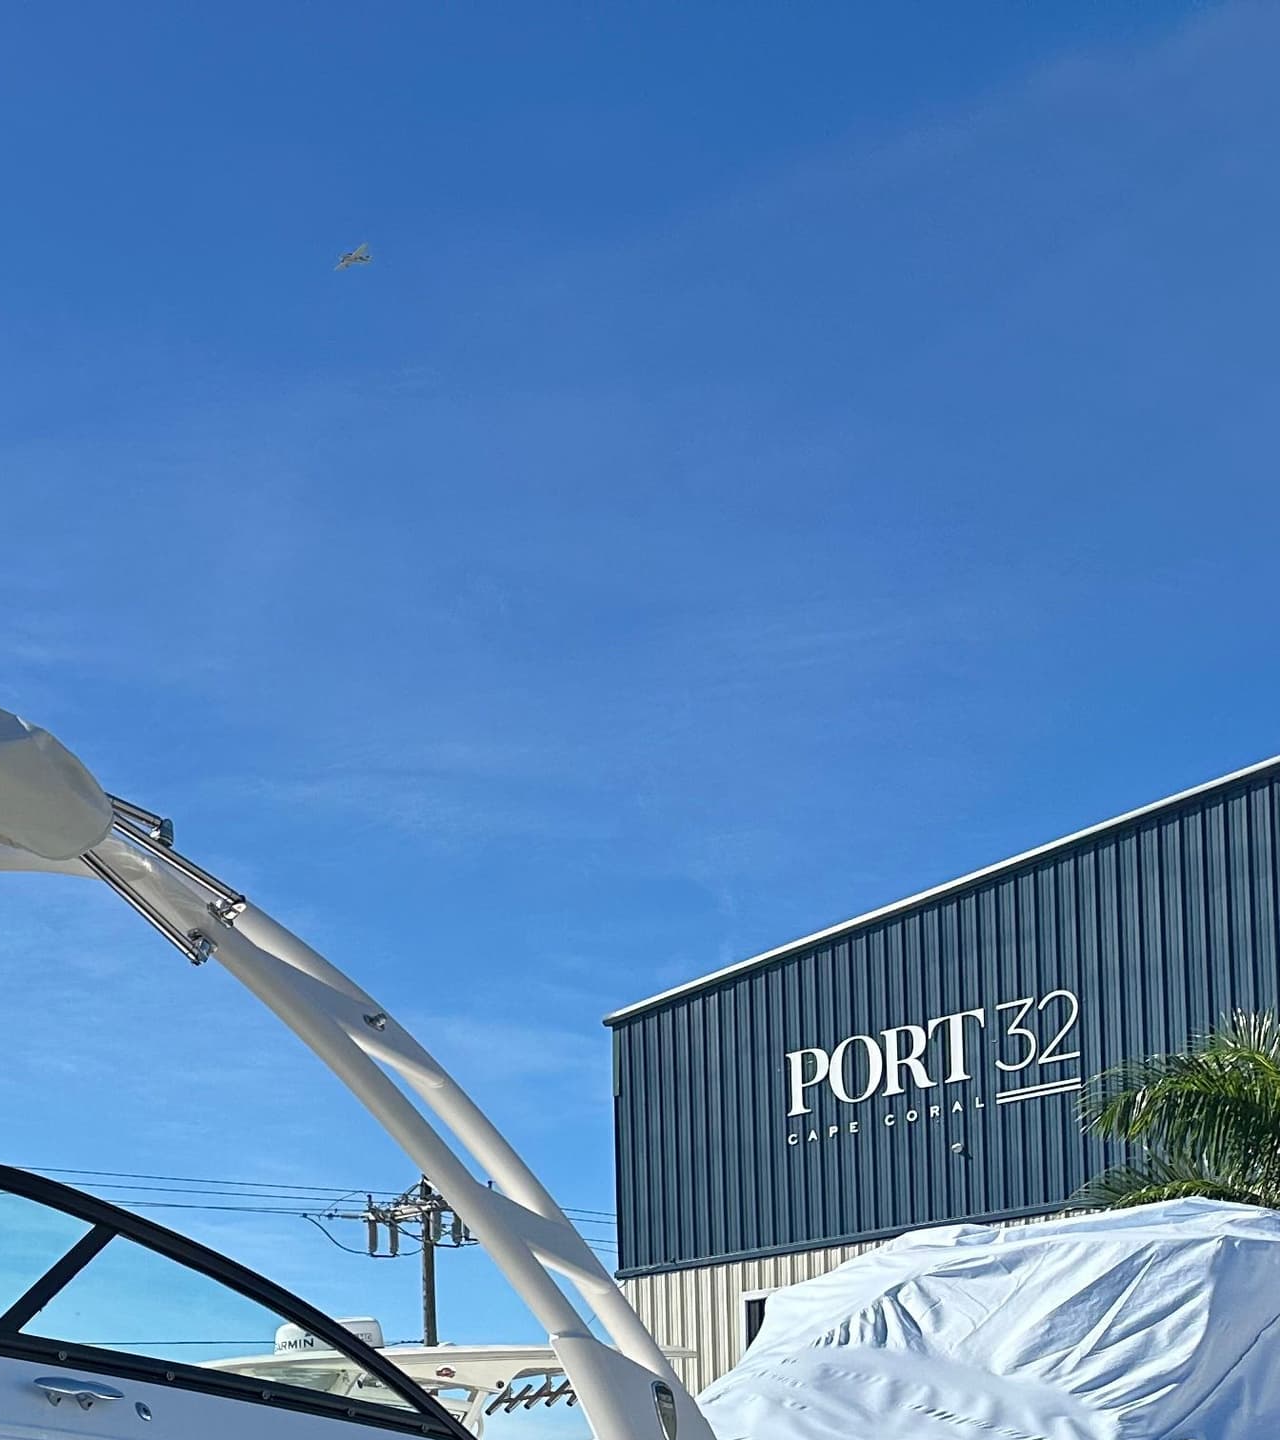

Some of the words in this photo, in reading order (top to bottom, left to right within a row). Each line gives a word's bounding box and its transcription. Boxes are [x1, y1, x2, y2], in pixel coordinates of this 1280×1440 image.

[785, 1008, 985, 1117] PORT
[995, 989, 1081, 1072] 32
[787, 1121, 859, 1146] CAPE
[884, 1096, 985, 1127] CORAL
